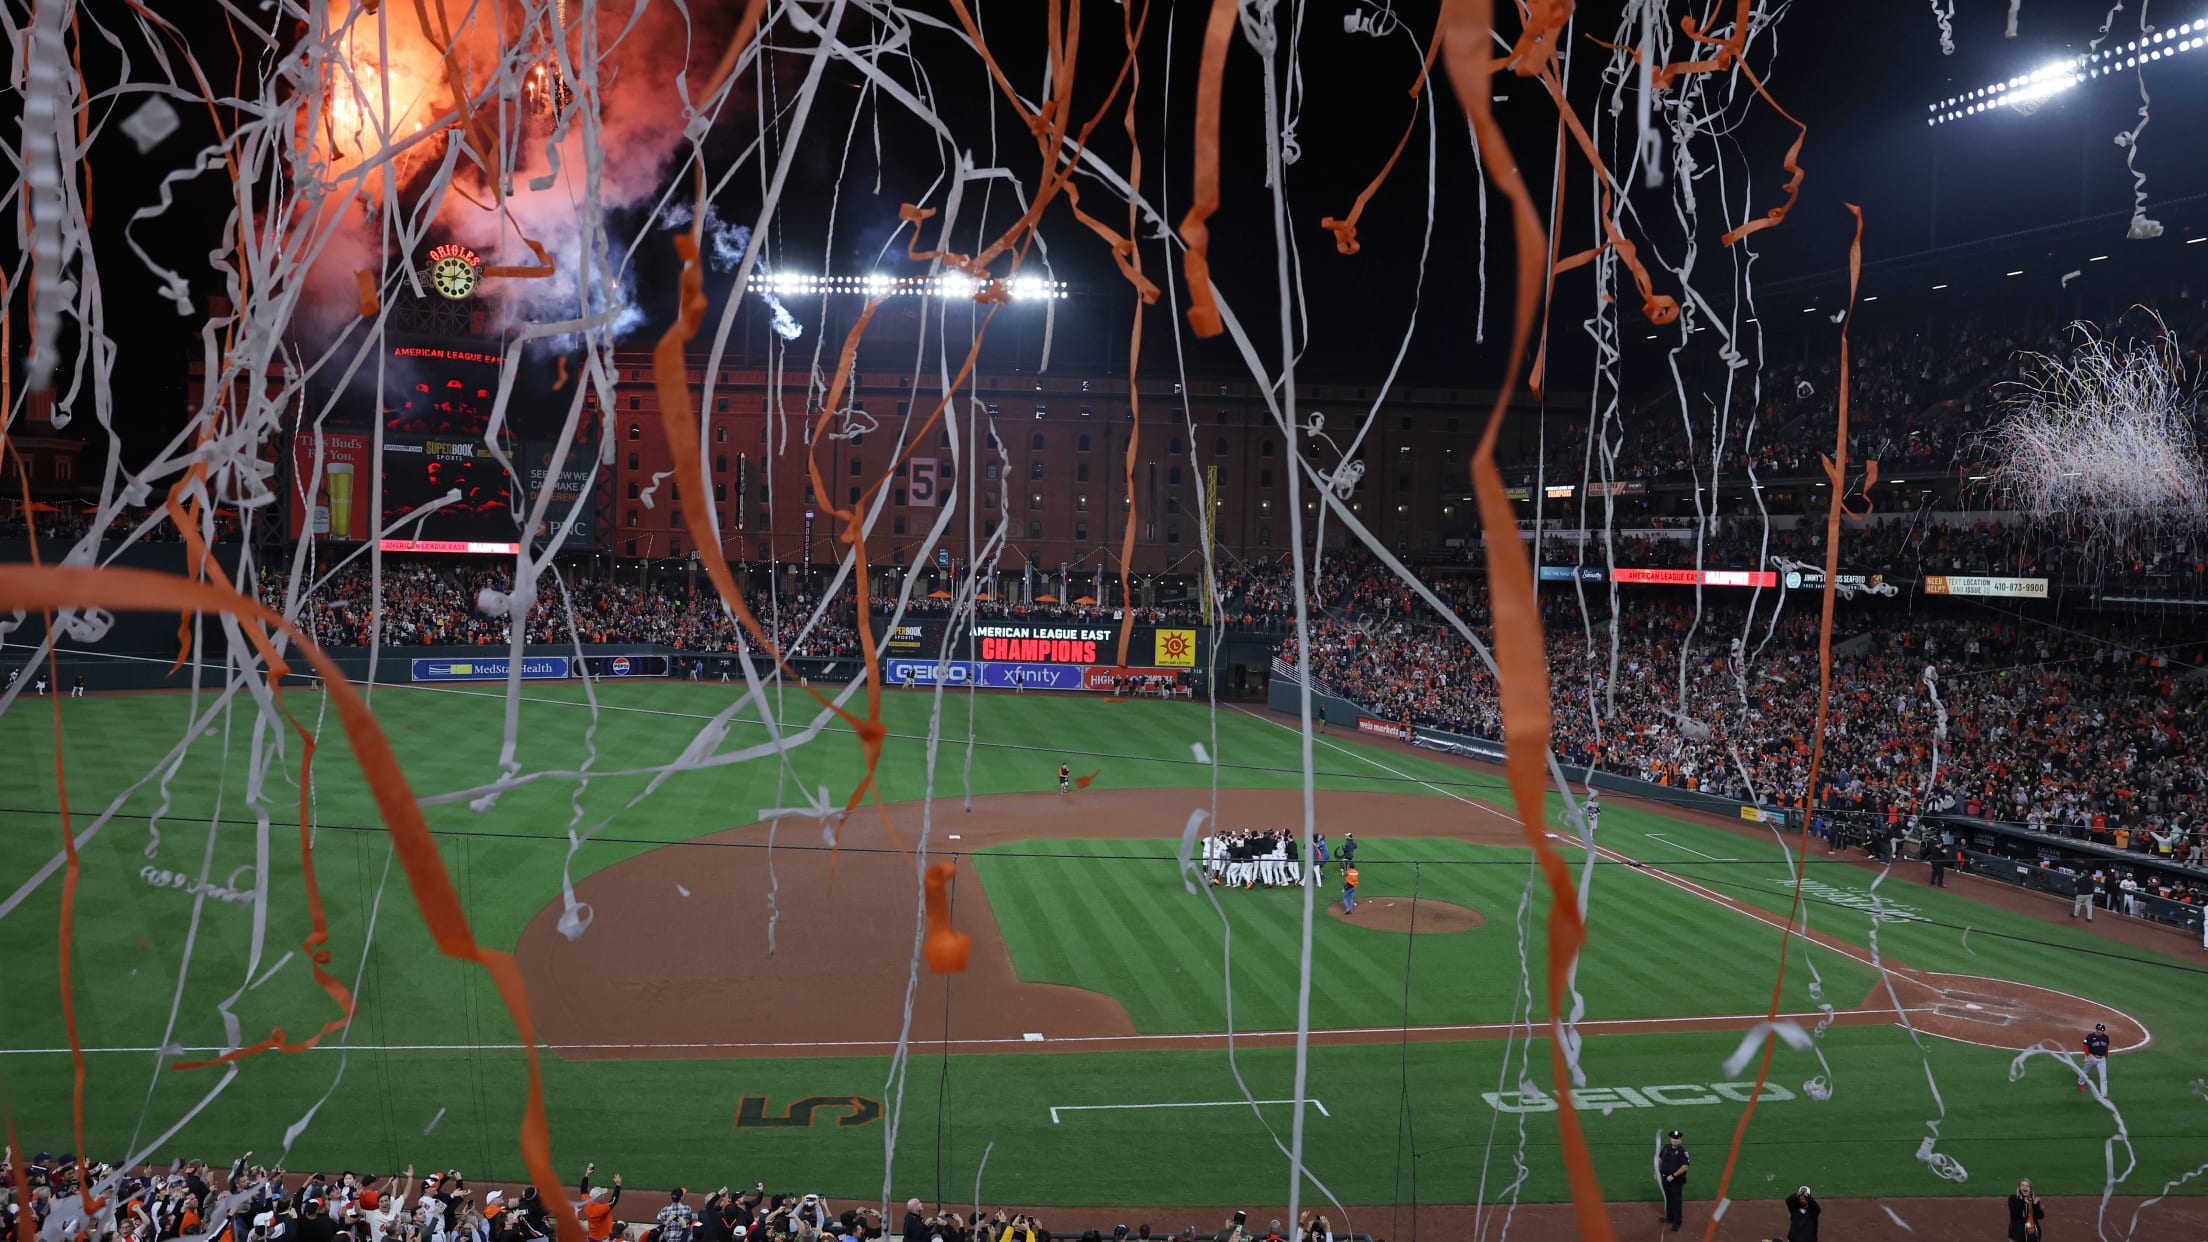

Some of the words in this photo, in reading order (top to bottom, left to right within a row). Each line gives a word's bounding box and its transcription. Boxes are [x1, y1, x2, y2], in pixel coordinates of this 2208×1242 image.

[430, 244, 480, 267] ORIOLES
[395, 347, 444, 359] AMERICAN
[447, 351, 483, 363] LEAGUE
[300, 435, 329, 447] Ths
[331, 438, 362, 449] Bud's
[426, 441, 474, 457] SUPERBOOK
[330, 450, 355, 461] You.
[912, 464, 934, 500] 5
[421, 542, 447, 551] LEAGUE
[448, 543, 466, 551] EAST
[1628, 572, 1660, 581] AMERICAN
[1661, 573, 1685, 582] LEAGUE
[1843, 575, 1866, 584] SEAFOOD
[1926, 577, 1943, 586] NEED
[1963, 578, 1991, 587] LOCATION
[1965, 586, 1982, 594] ISSUE
[1994, 582, 2045, 593] 410-873-9900
[969, 626, 1027, 638] AMERICAN
[1033, 628, 1077, 640] LEAGUE
[1081, 630, 1112, 641] EAST
[982, 637, 1097, 663] CHAMPIONS
[613, 662, 630, 670] PEPSI
[1003, 666, 1060, 688] xfinity
[1359, 721, 1373, 731] weis
[1374, 724, 1399, 736] markets
[1481, 1081, 1797, 1113] GEICO
[733, 1095, 884, 1129] 5
